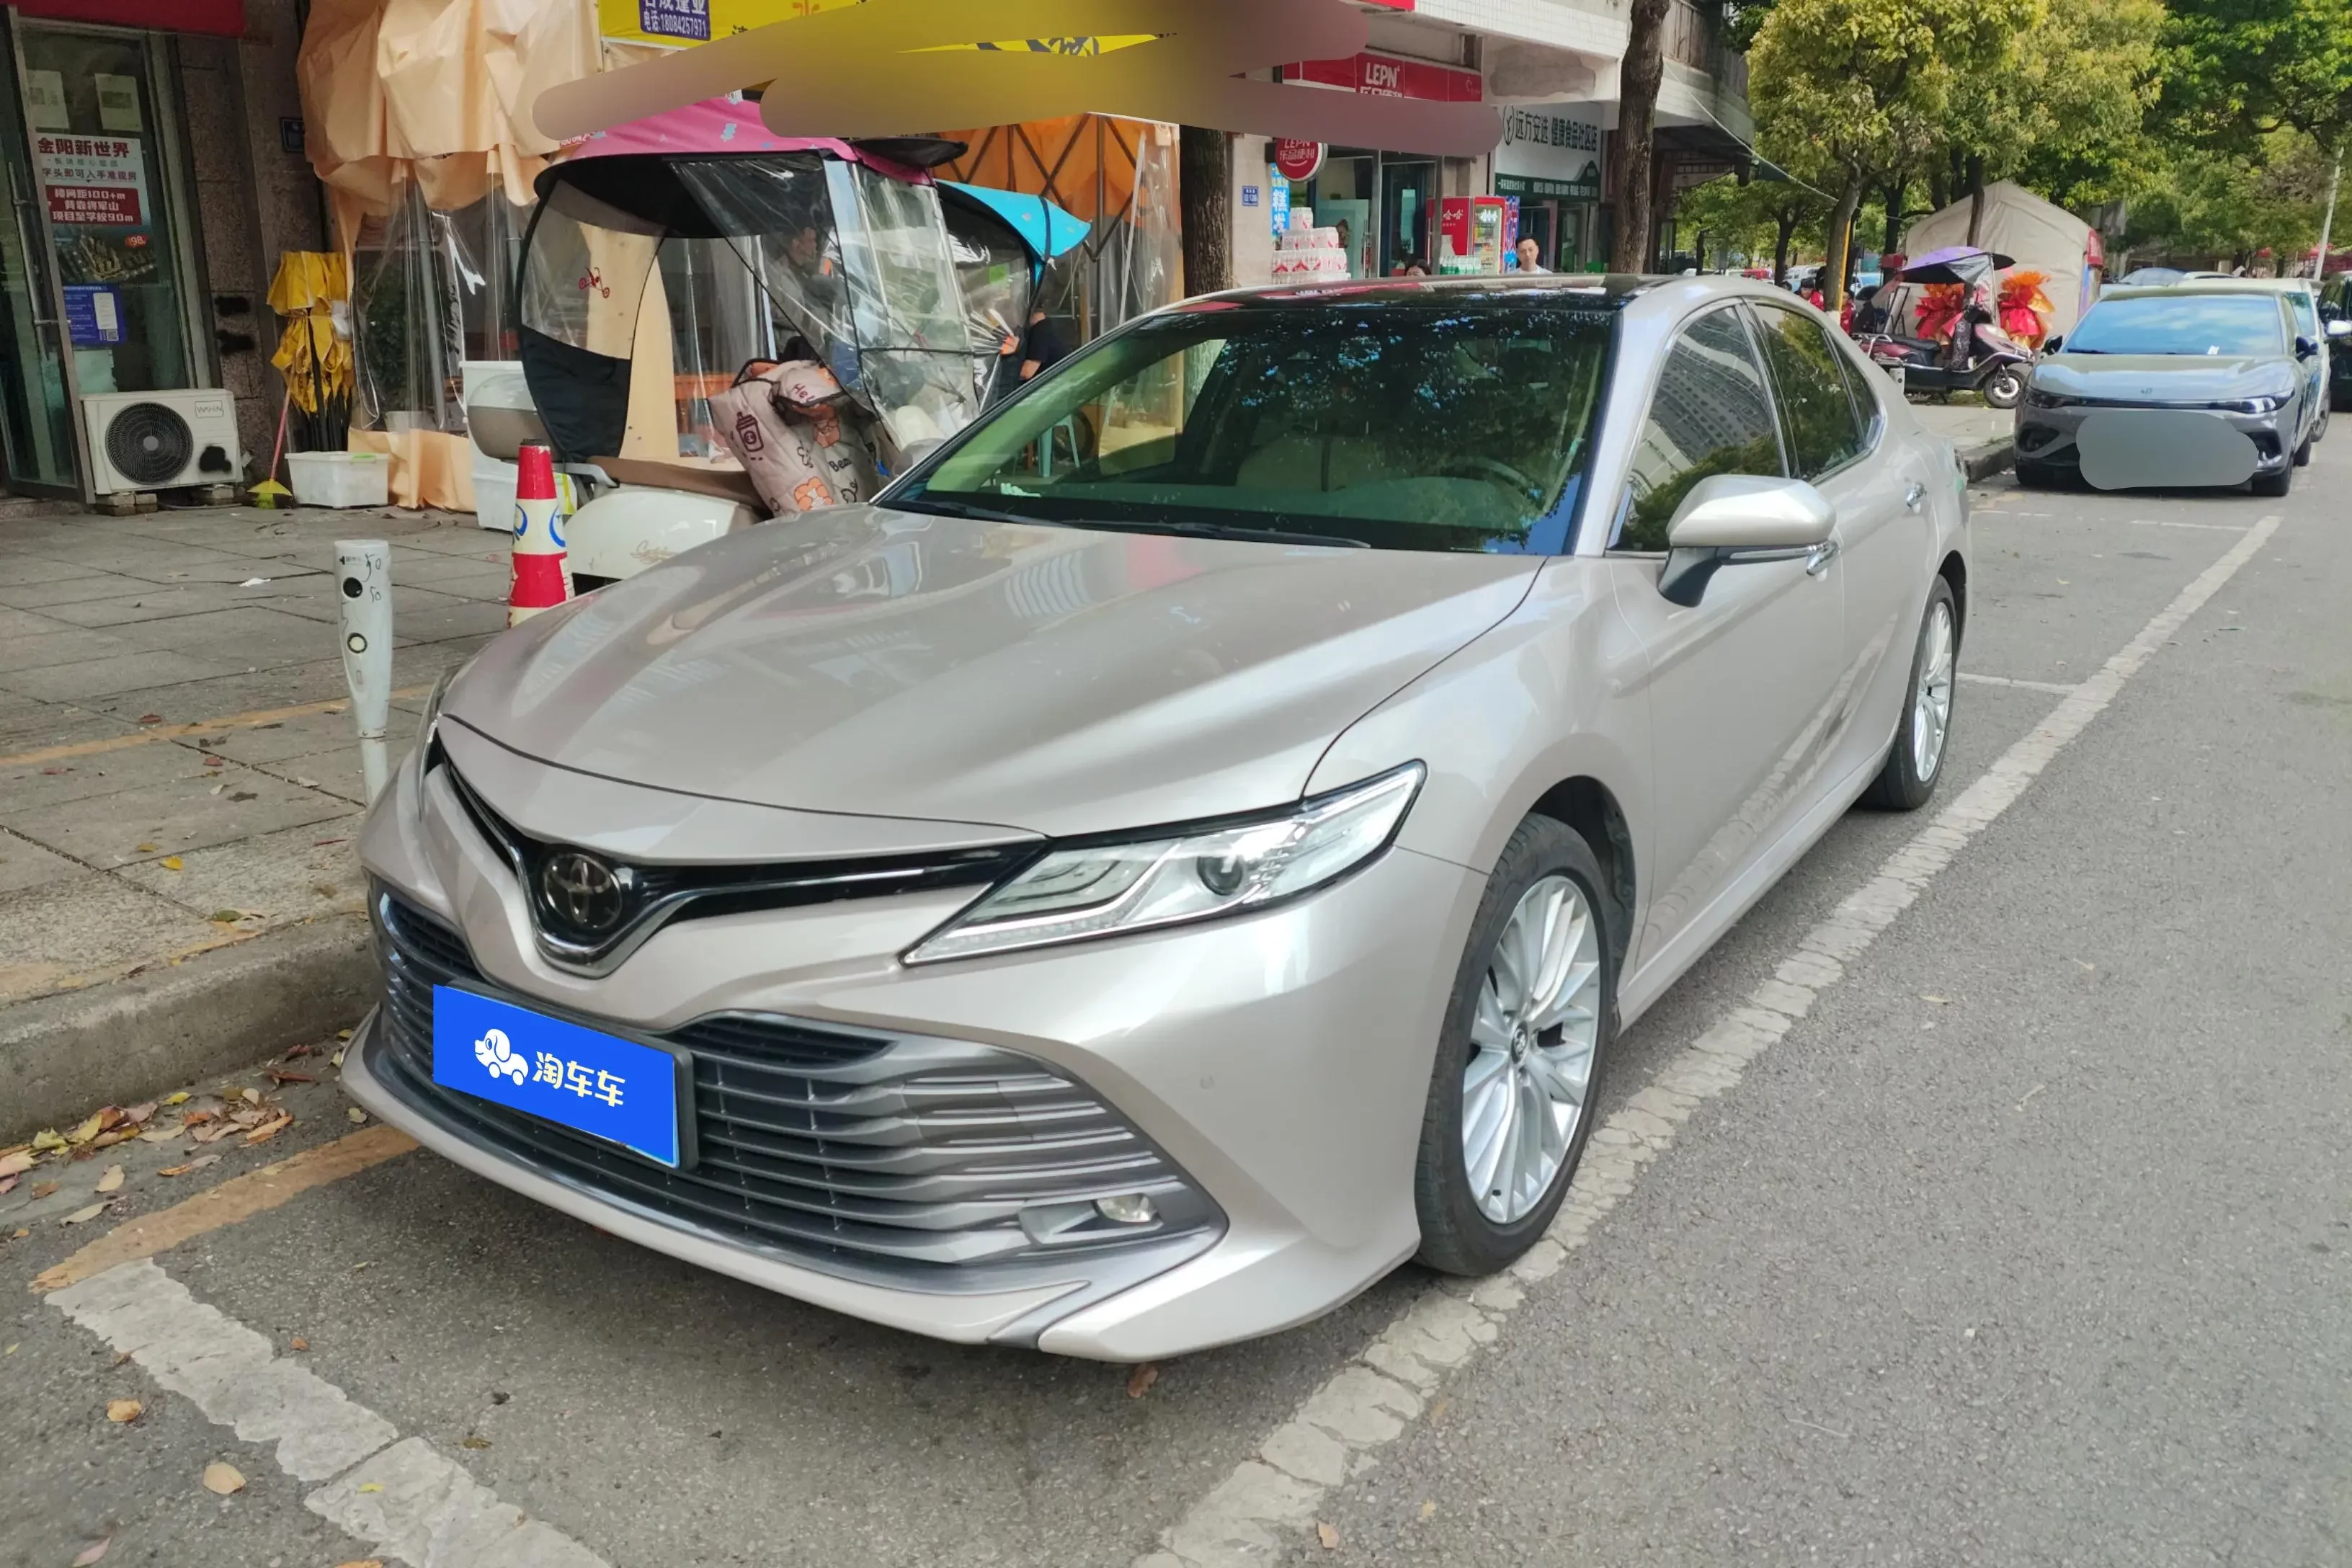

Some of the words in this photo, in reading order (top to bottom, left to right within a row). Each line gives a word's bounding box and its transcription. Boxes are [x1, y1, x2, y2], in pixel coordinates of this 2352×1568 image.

[1365, 62, 1399, 88] LEPN
[37, 137, 130, 158] 金阳新世界
